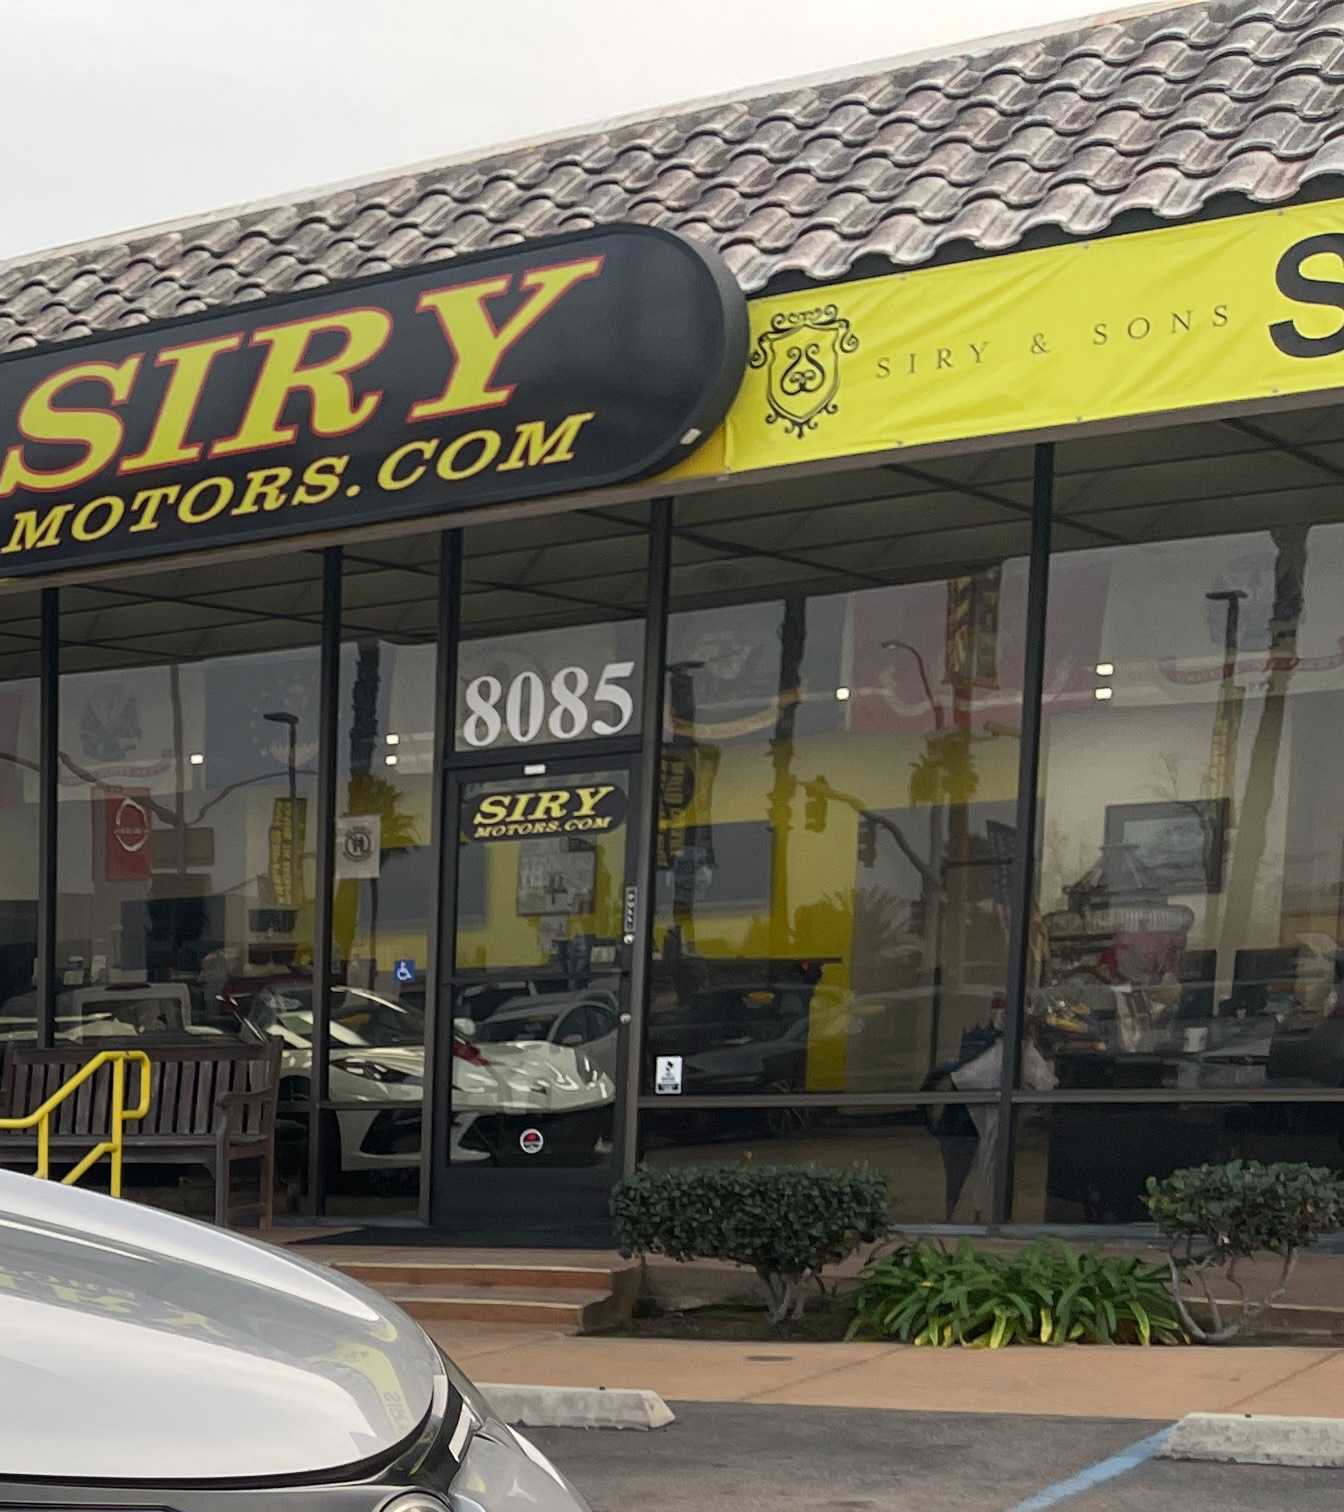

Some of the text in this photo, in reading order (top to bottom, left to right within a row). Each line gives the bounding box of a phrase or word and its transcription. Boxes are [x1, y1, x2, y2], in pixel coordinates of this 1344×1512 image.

[875, 303, 1230, 380] SIRY & SONS
[463, 661, 635, 747] 8085
[473, 786, 615, 826] SIRY
[474, 817, 612, 838] MOTORS.COM
